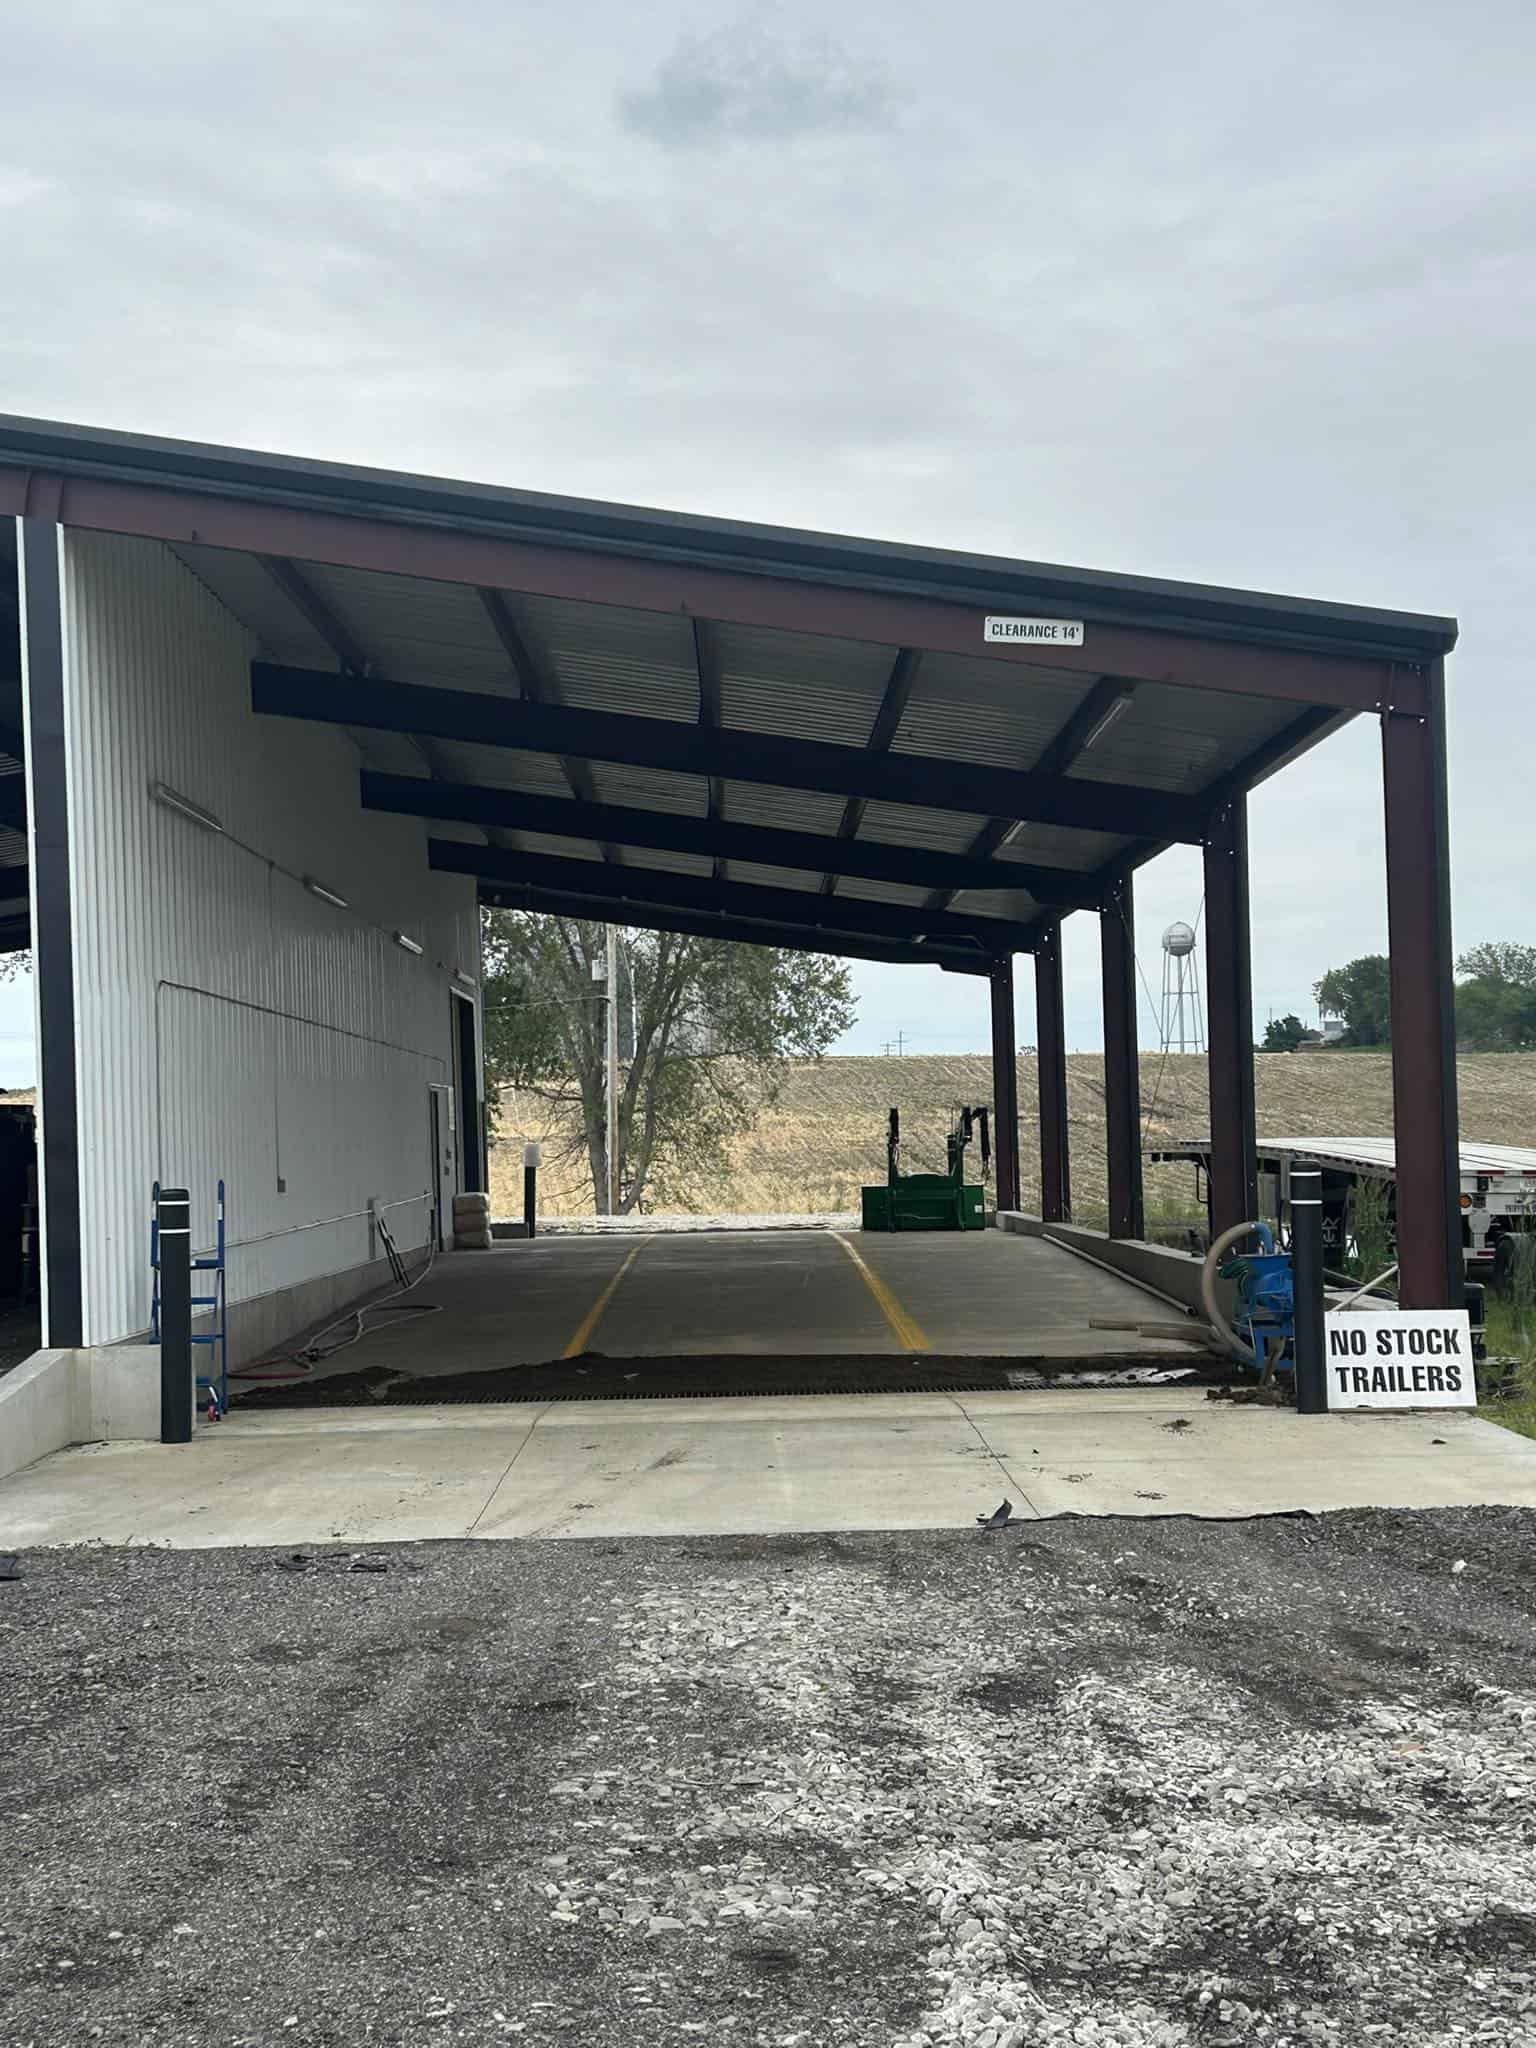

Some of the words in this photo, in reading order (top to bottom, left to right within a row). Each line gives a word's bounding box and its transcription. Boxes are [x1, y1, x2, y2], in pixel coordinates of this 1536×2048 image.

[992, 623, 1058, 638] CLEARANCE
[1062, 626, 1079, 639] 14'
[1330, 1329, 1367, 1356] NO
[1376, 1328, 1461, 1355] STOCK
[1335, 1365, 1462, 1393] TRAILERS
